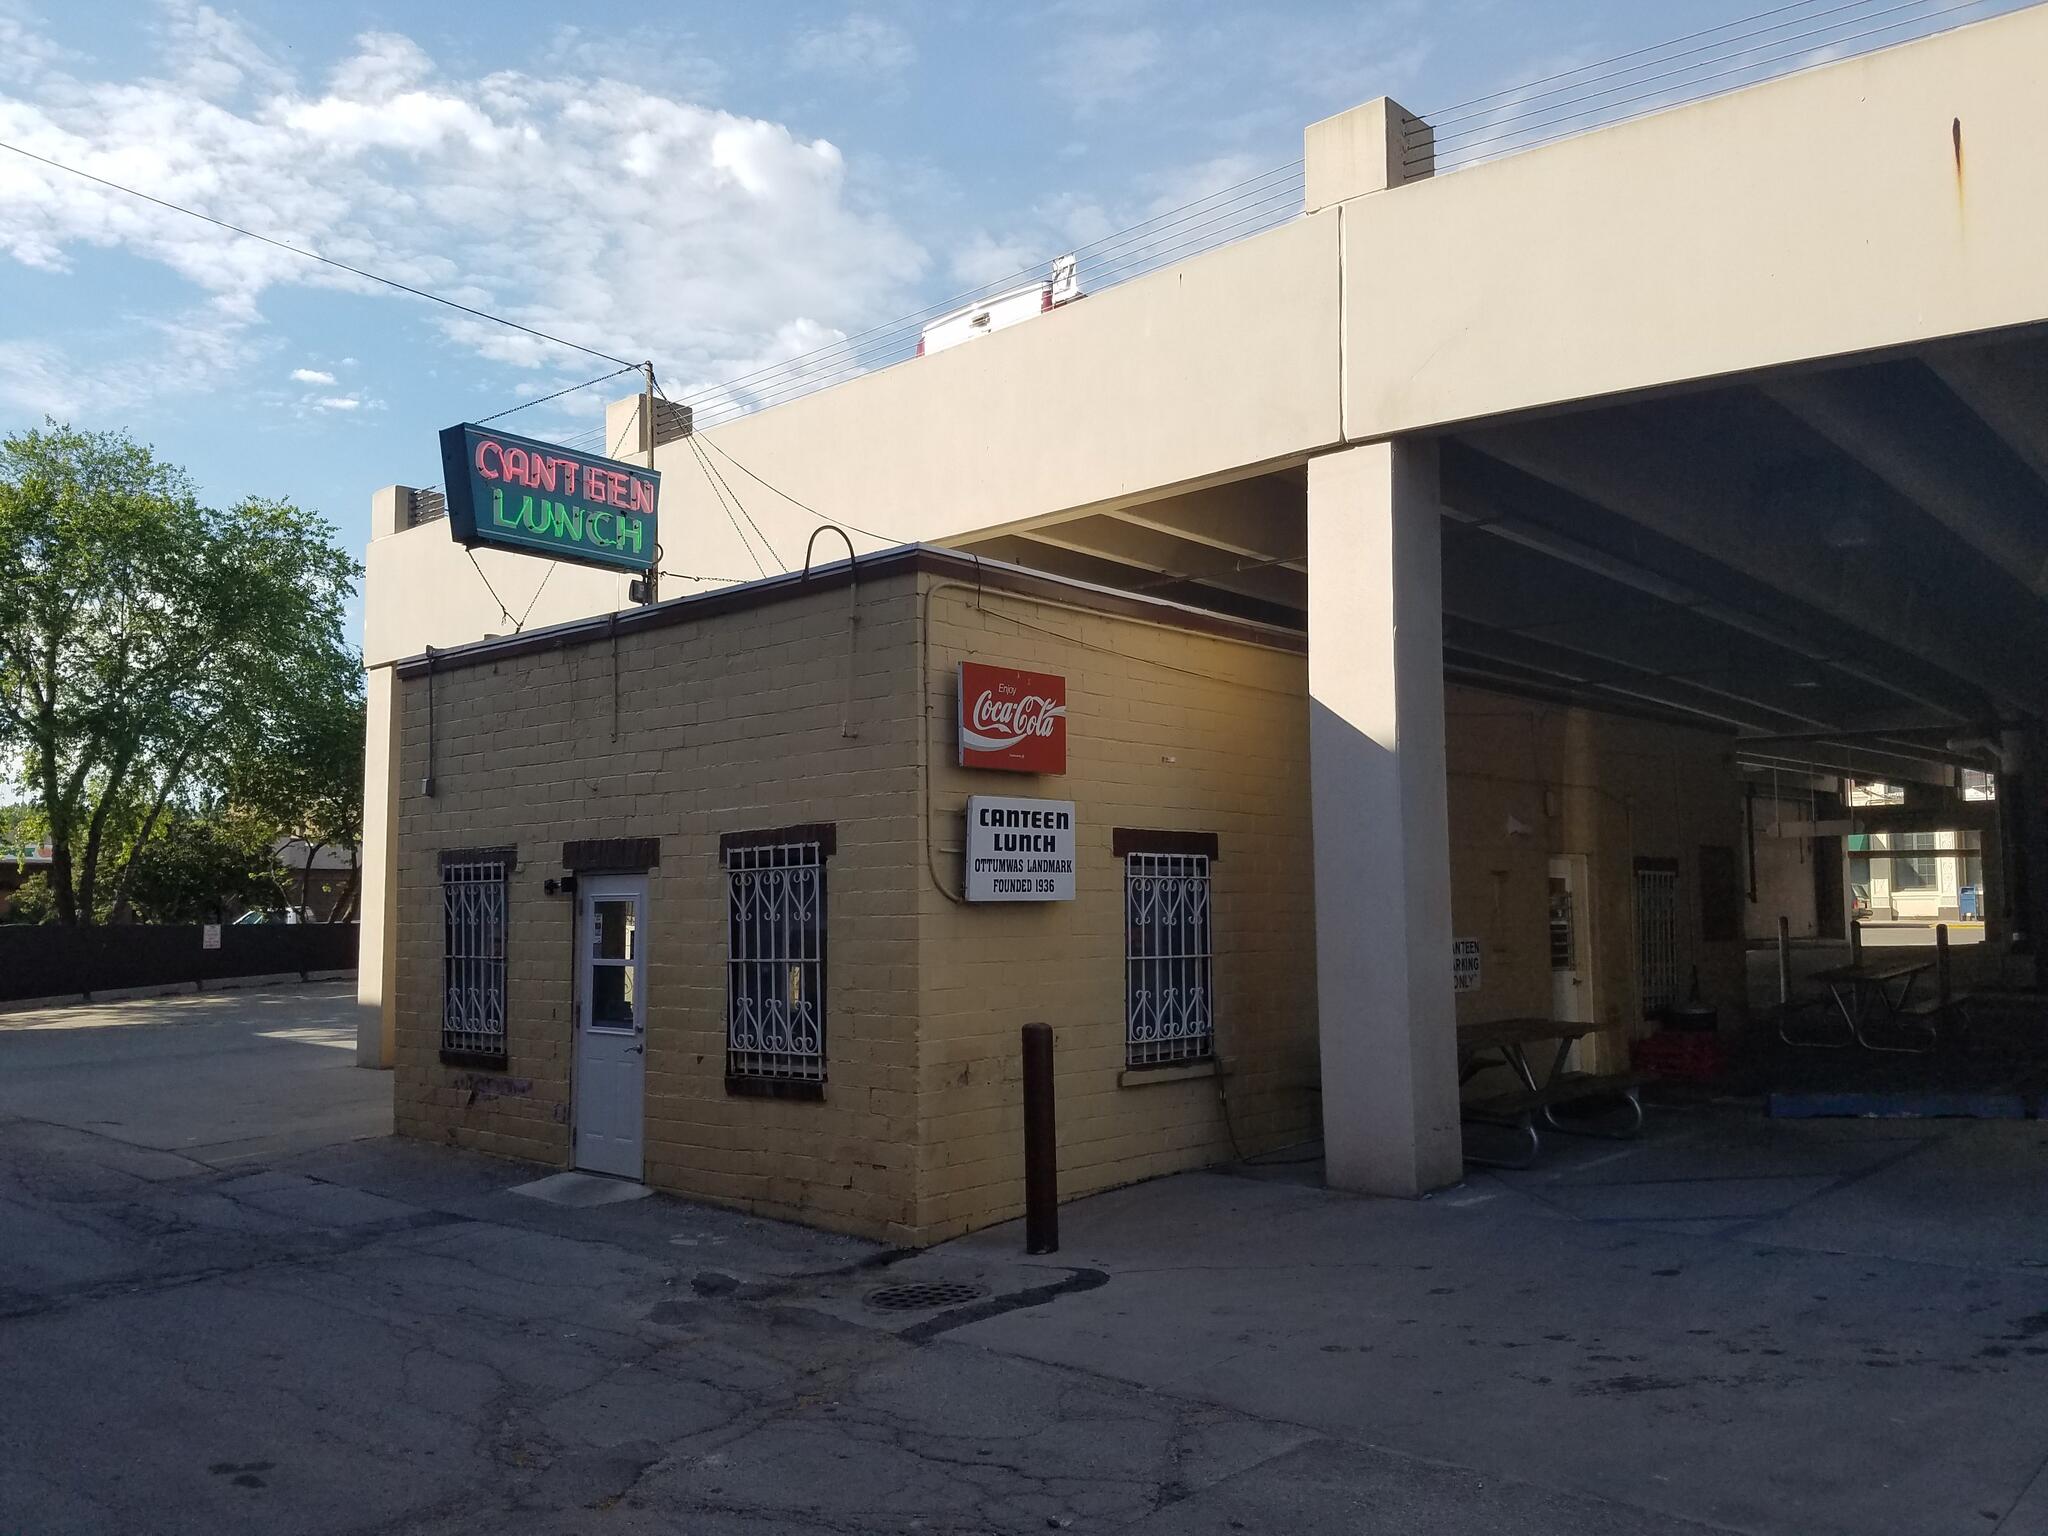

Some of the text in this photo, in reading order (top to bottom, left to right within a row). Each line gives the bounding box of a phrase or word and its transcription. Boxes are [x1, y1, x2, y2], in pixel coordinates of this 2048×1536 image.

[476, 441, 654, 513] CANTEEN
[492, 488, 642, 553] LUNCH
[998, 683, 1017, 696] Enjoy
[973, 689, 1056, 737] Coca-Cola
[980, 808, 1069, 830] CANTEEN
[993, 833, 1056, 853] LUNCH
[974, 858, 1073, 873] OTTUMWAS LANDMARK
[993, 878, 1055, 893] FOUNDED 1936
[1452, 941, 1480, 955] NTEEN
[1453, 957, 1479, 971] RKING
